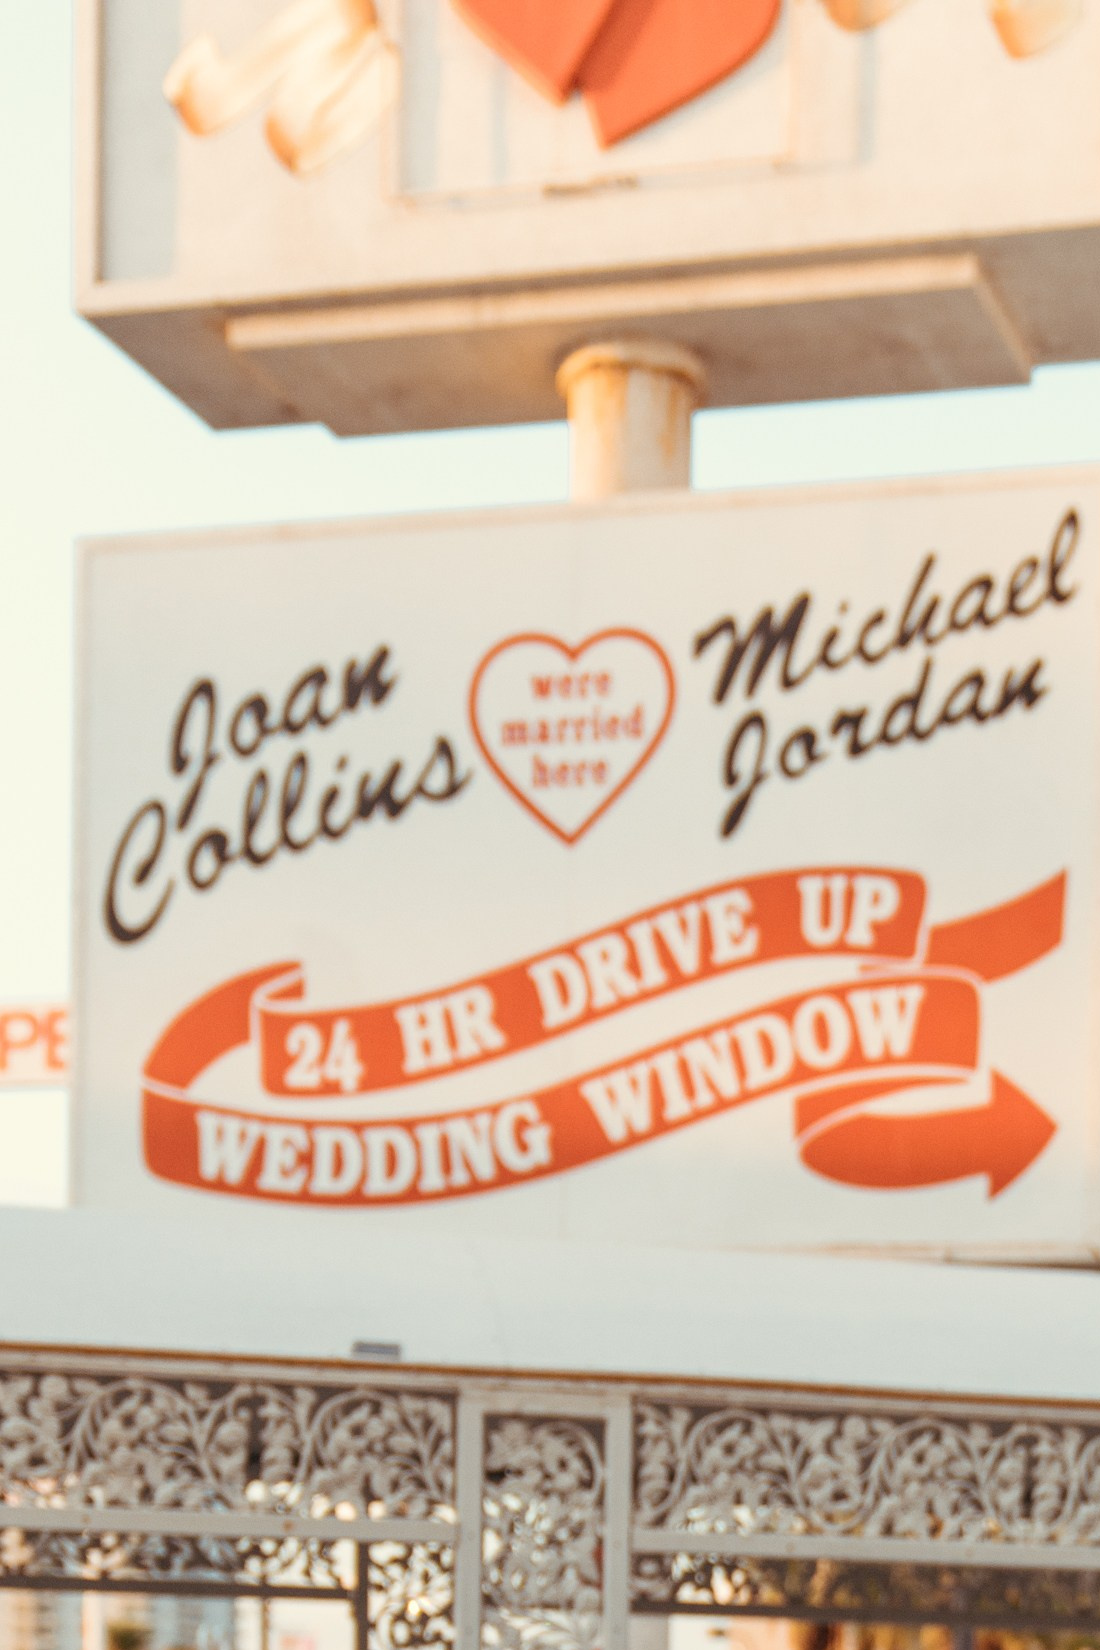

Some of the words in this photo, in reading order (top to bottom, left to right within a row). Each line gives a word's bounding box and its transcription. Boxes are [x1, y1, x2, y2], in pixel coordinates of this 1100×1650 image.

[531, 671, 611, 697] were
[693, 506, 1081, 704] Michael
[169, 643, 398, 831] Joan
[502, 704, 644, 746] married
[531, 755, 609, 789] here
[719, 655, 1047, 840] Jordan
[102, 734, 474, 945] Collins
[283, 1018, 363, 1093] 24
[395, 986, 506, 1075] HR
[527, 888, 759, 1029] DRIVE
[797, 874, 900, 948] UP
[195, 1098, 553, 1198] WEDDING
[580, 984, 925, 1144] WINDOW
